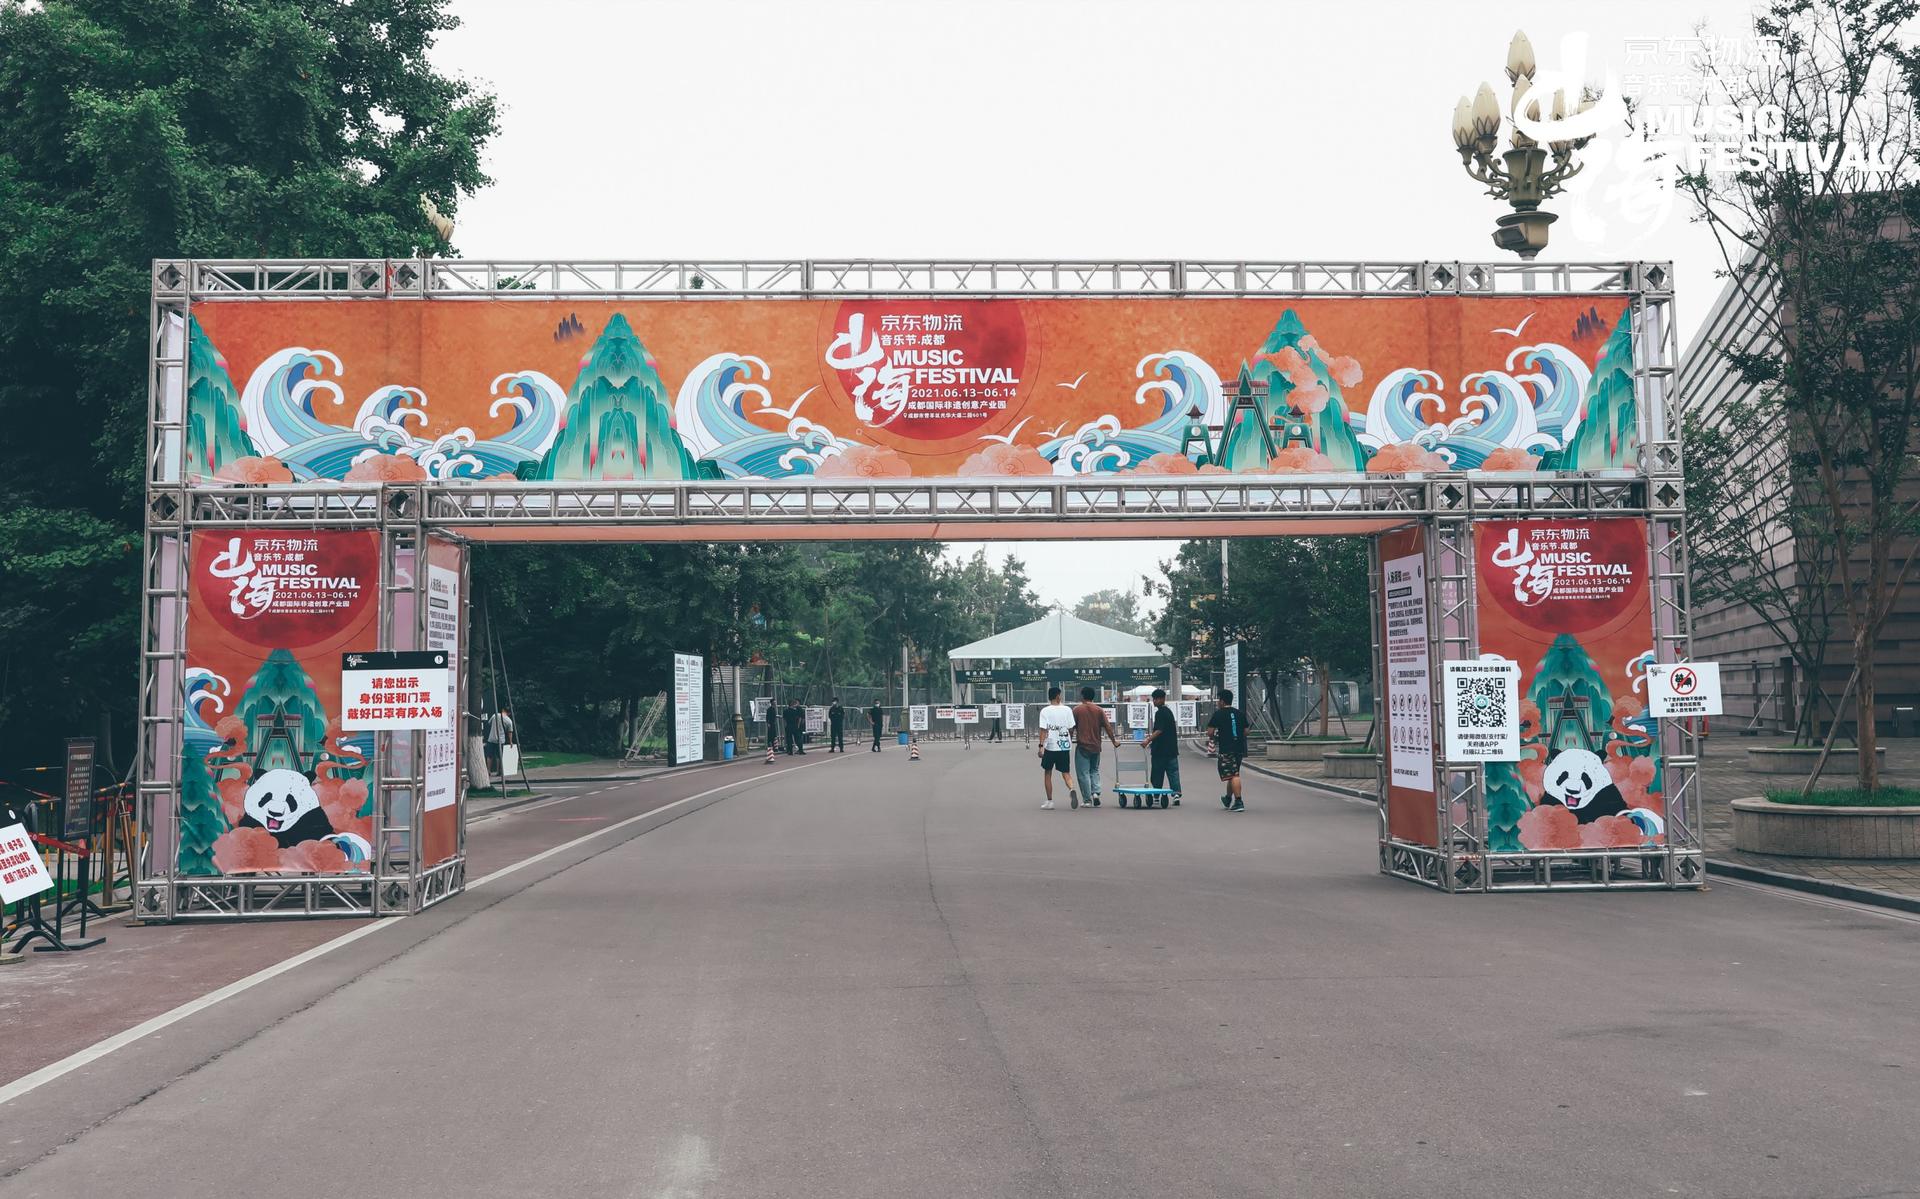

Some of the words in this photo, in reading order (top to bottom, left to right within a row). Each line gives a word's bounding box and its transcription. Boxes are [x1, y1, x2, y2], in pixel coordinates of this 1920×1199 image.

[881, 314, 963, 331] 京东物流
[893, 349, 964, 366] MUSIC
[915, 367, 1019, 384] FESTIVAL
[911, 388, 1017, 398] 2021.06.13-06.14
[907, 400, 1007, 410] 成都国际非遗创意产业园
[1531, 528, 1590, 540] 京东物流
[254, 538, 318, 551] 京东物流
[1541, 552, 1592, 564] MUSIC
[262, 564, 317, 576] MUSIC
[1557, 564, 1632, 576] FESTIVAL
[279, 577, 361, 589] FESTIVAL
[1555, 578, 1631, 586] 2021.06.13-06.14
[371, 677, 419, 689] 请您出示
[359, 692, 431, 704] 身份证和门票
[347, 706, 443, 720] 戴好口罩有序入场
